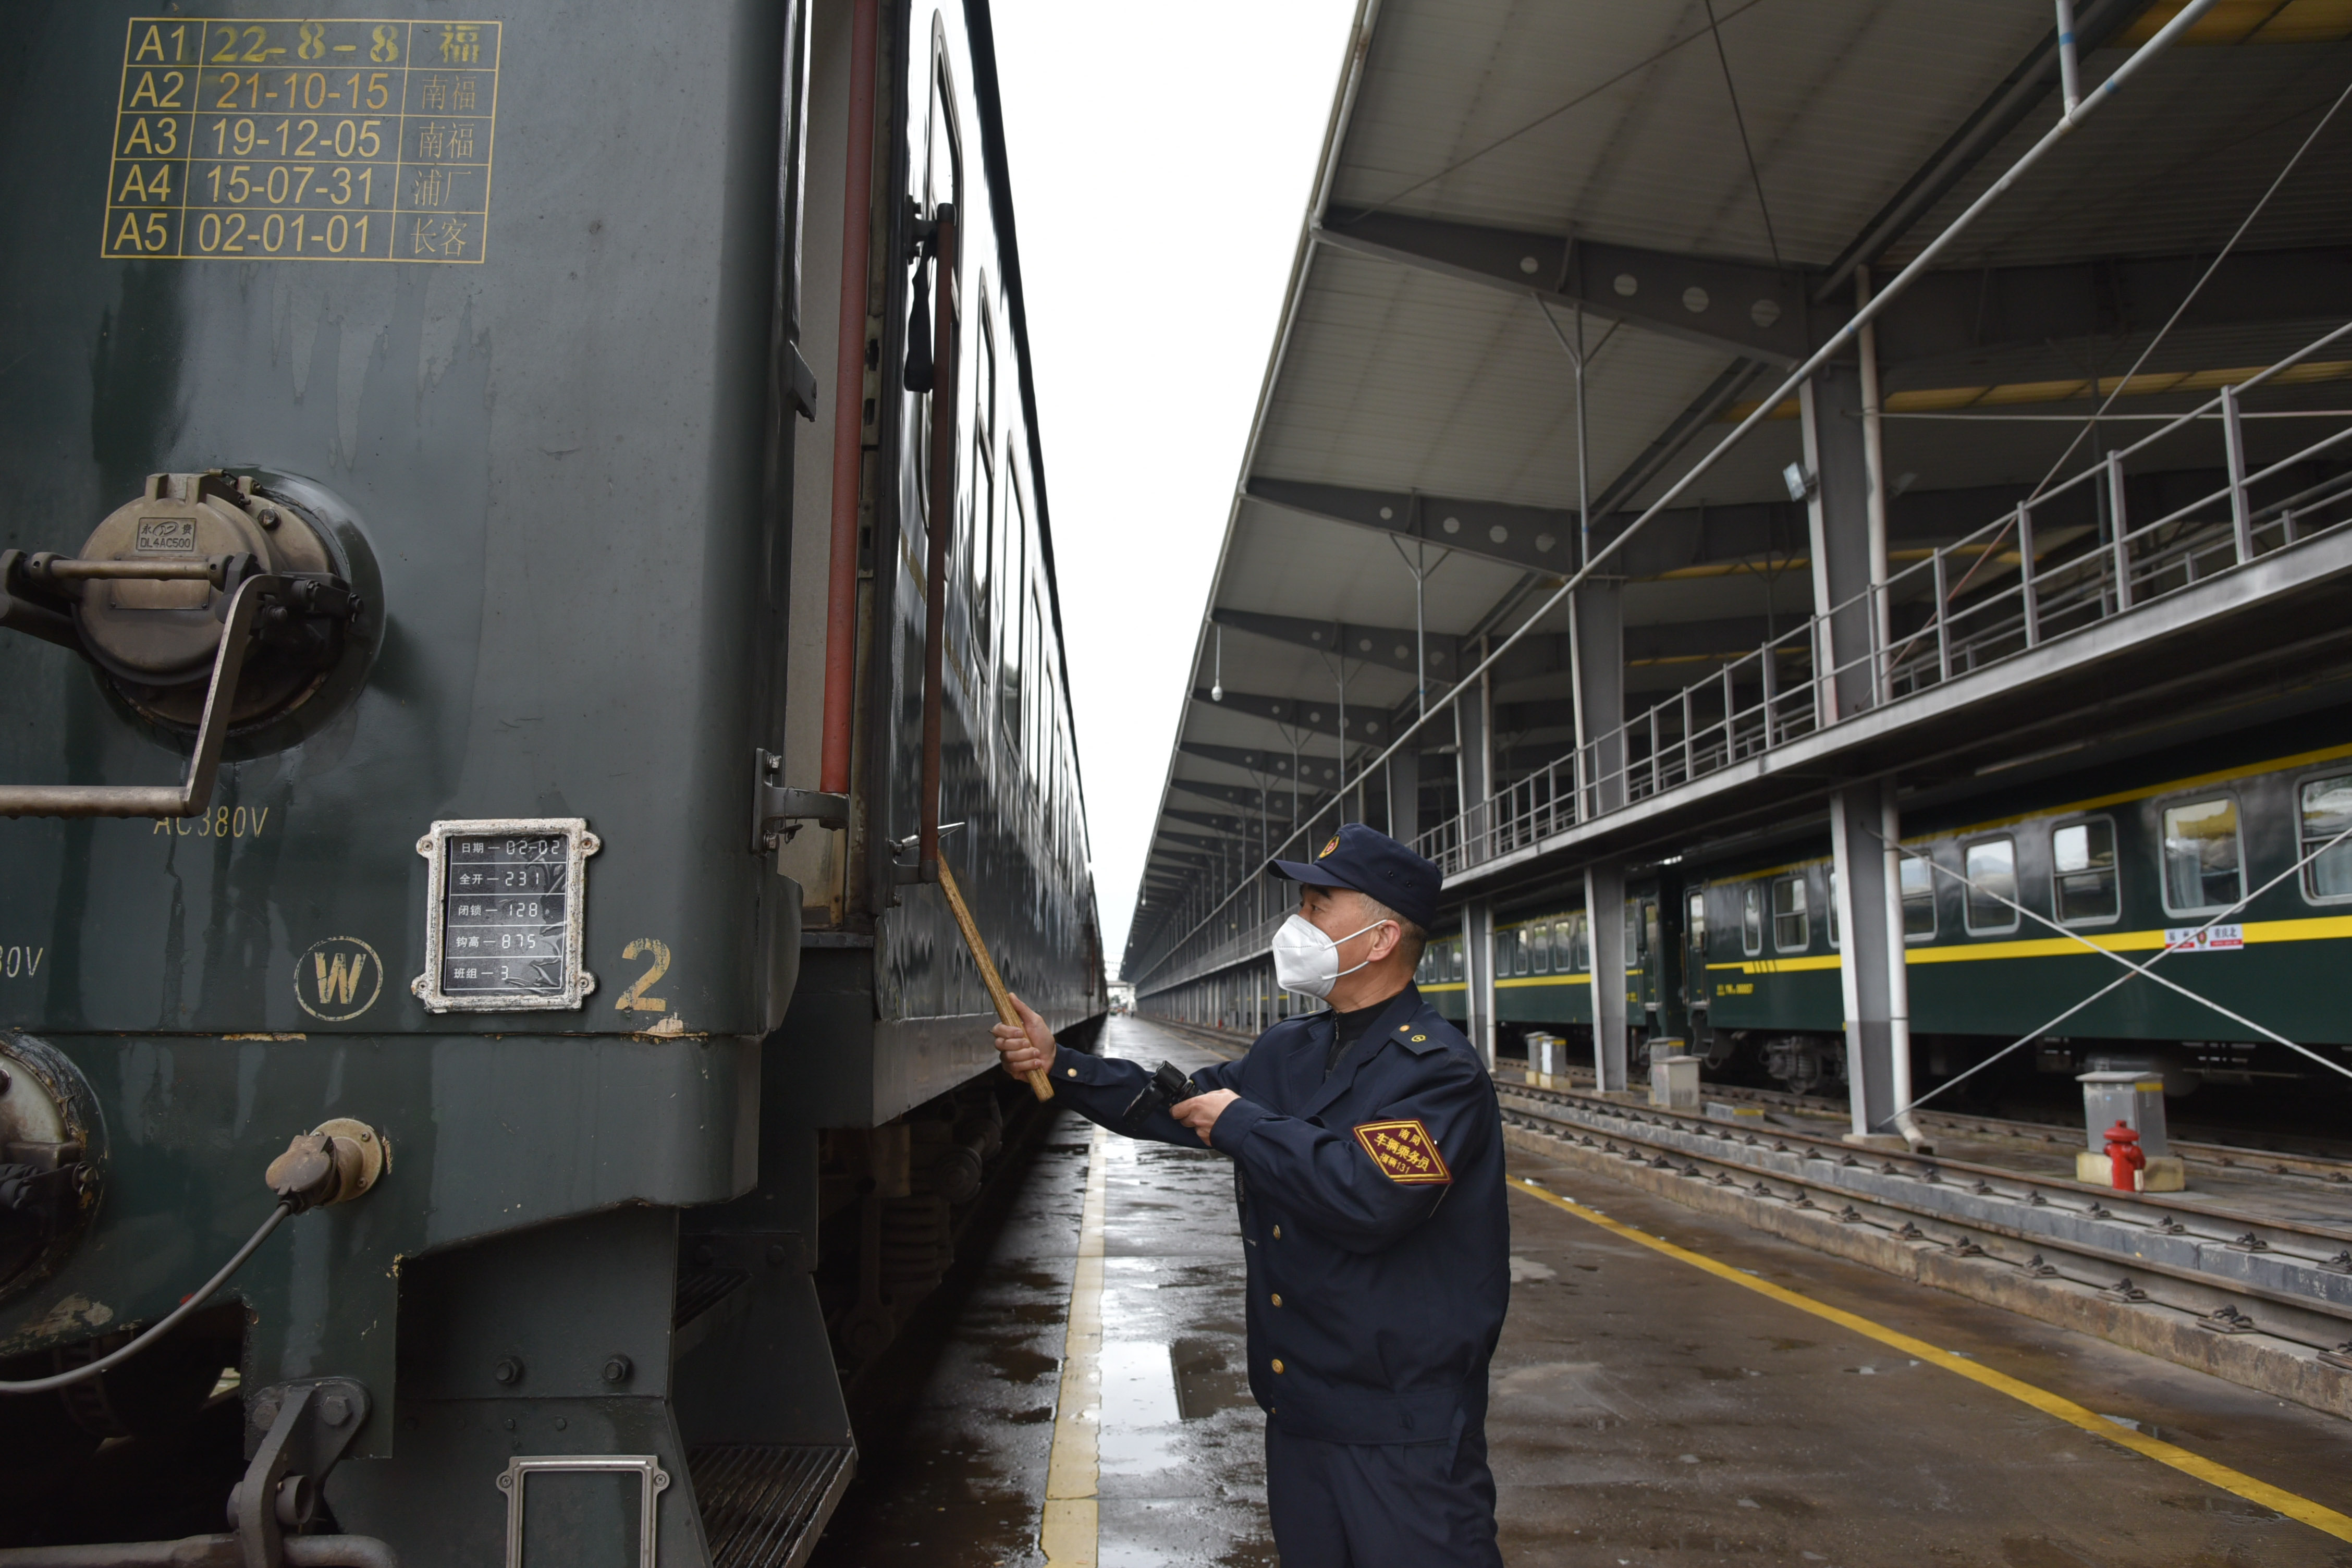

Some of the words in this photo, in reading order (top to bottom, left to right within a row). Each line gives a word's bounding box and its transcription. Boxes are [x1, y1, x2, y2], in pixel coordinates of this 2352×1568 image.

[136, 25, 184, 61] A1
[130, 71, 183, 107] A2
[217, 72, 388, 109] 21-10-15
[422, 75, 476, 110] 南福
[124, 117, 177, 154] A3
[212, 118, 381, 156] 19-12-05
[419, 121, 473, 159] 南福
[118, 164, 170, 202] A4
[207, 165, 372, 203] 15-07-31
[414, 168, 471, 206] 浦厂
[114, 213, 167, 251] A5
[199, 213, 368, 253] 02-01-01
[410, 217, 467, 257] 长客
[140, 537, 191, 548] DL4AC500
[462, 842, 484, 853] 日期
[460, 874, 483, 885] 全开
[505, 872, 538, 886] 231
[458, 905, 481, 916] 闭锁
[510, 903, 537, 917] 128
[456, 936, 479, 947] 钩高
[314, 952, 366, 1005] W
[454, 967, 477, 978] 班组
[501, 966, 508, 980] 3
[615, 938, 671, 1011] 2
[1374, 1132, 1430, 1172] 车辆乘务员
[1398, 1128, 1421, 1146] 南局
